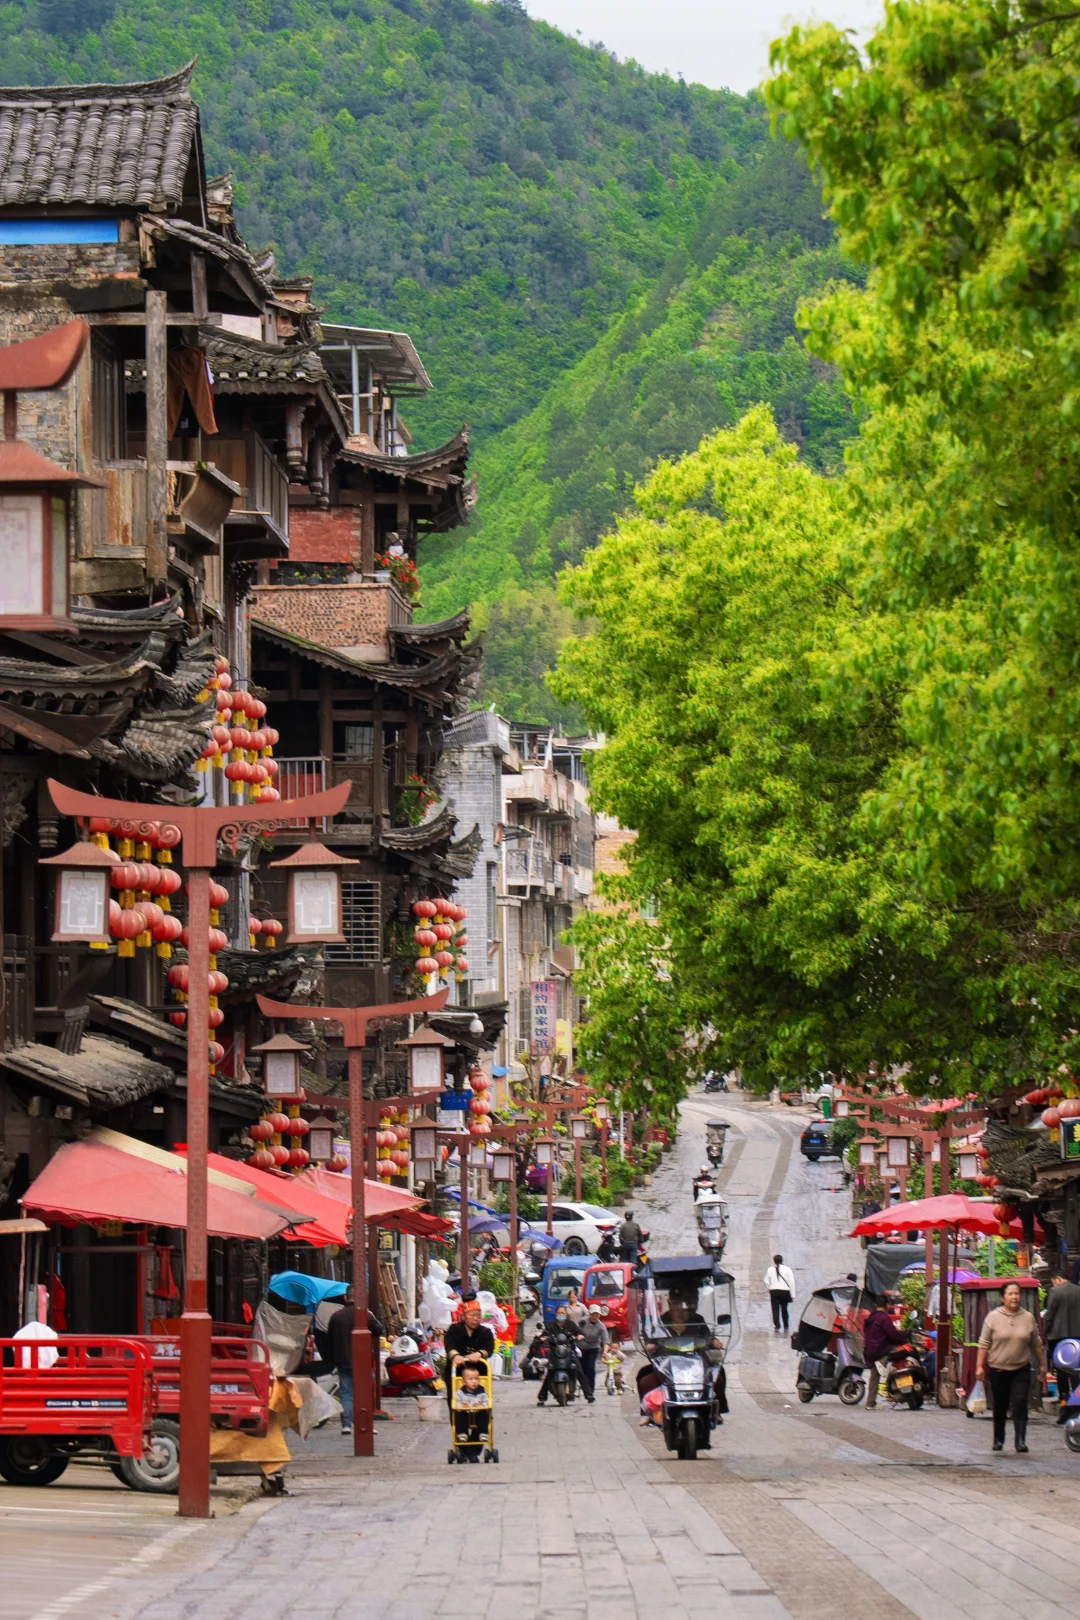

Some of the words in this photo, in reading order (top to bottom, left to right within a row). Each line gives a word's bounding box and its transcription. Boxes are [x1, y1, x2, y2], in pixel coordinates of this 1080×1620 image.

[534, 983, 548, 1048] 相约苗家饭馆
